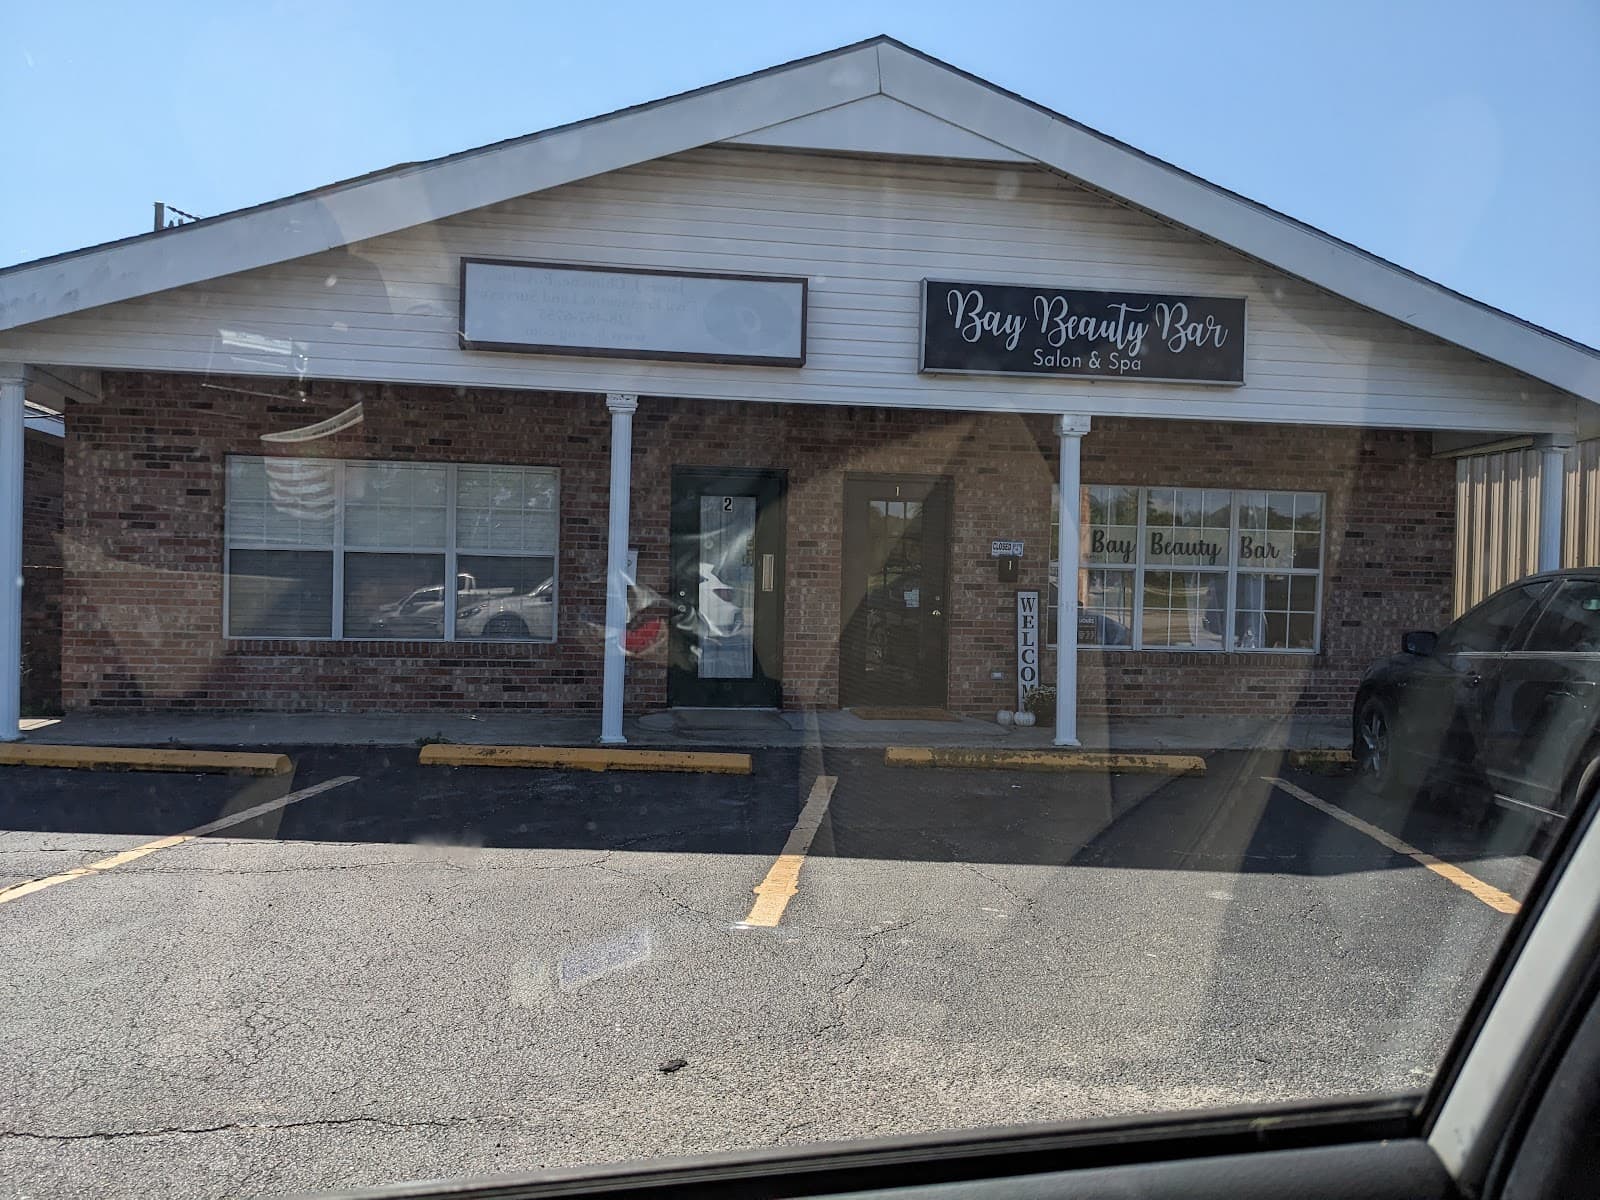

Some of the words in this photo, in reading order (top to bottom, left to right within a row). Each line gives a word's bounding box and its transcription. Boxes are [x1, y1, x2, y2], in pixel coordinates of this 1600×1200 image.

[947, 289, 1027, 351] Bay
[1033, 295, 1150, 356] Beauty
[1155, 302, 1228, 353] Bar
[1033, 349, 1081, 368] Salon
[1088, 351, 1101, 370] &
[1108, 353, 1142, 374] Spa
[723, 497, 732, 512] 2
[992, 542, 1012, 551] CLOSED
[1092, 529, 1136, 563] Bay
[1150, 532, 1222, 563] Beauty
[1239, 536, 1280, 560] Bar
[1020, 597, 1037, 699] WELCOM
